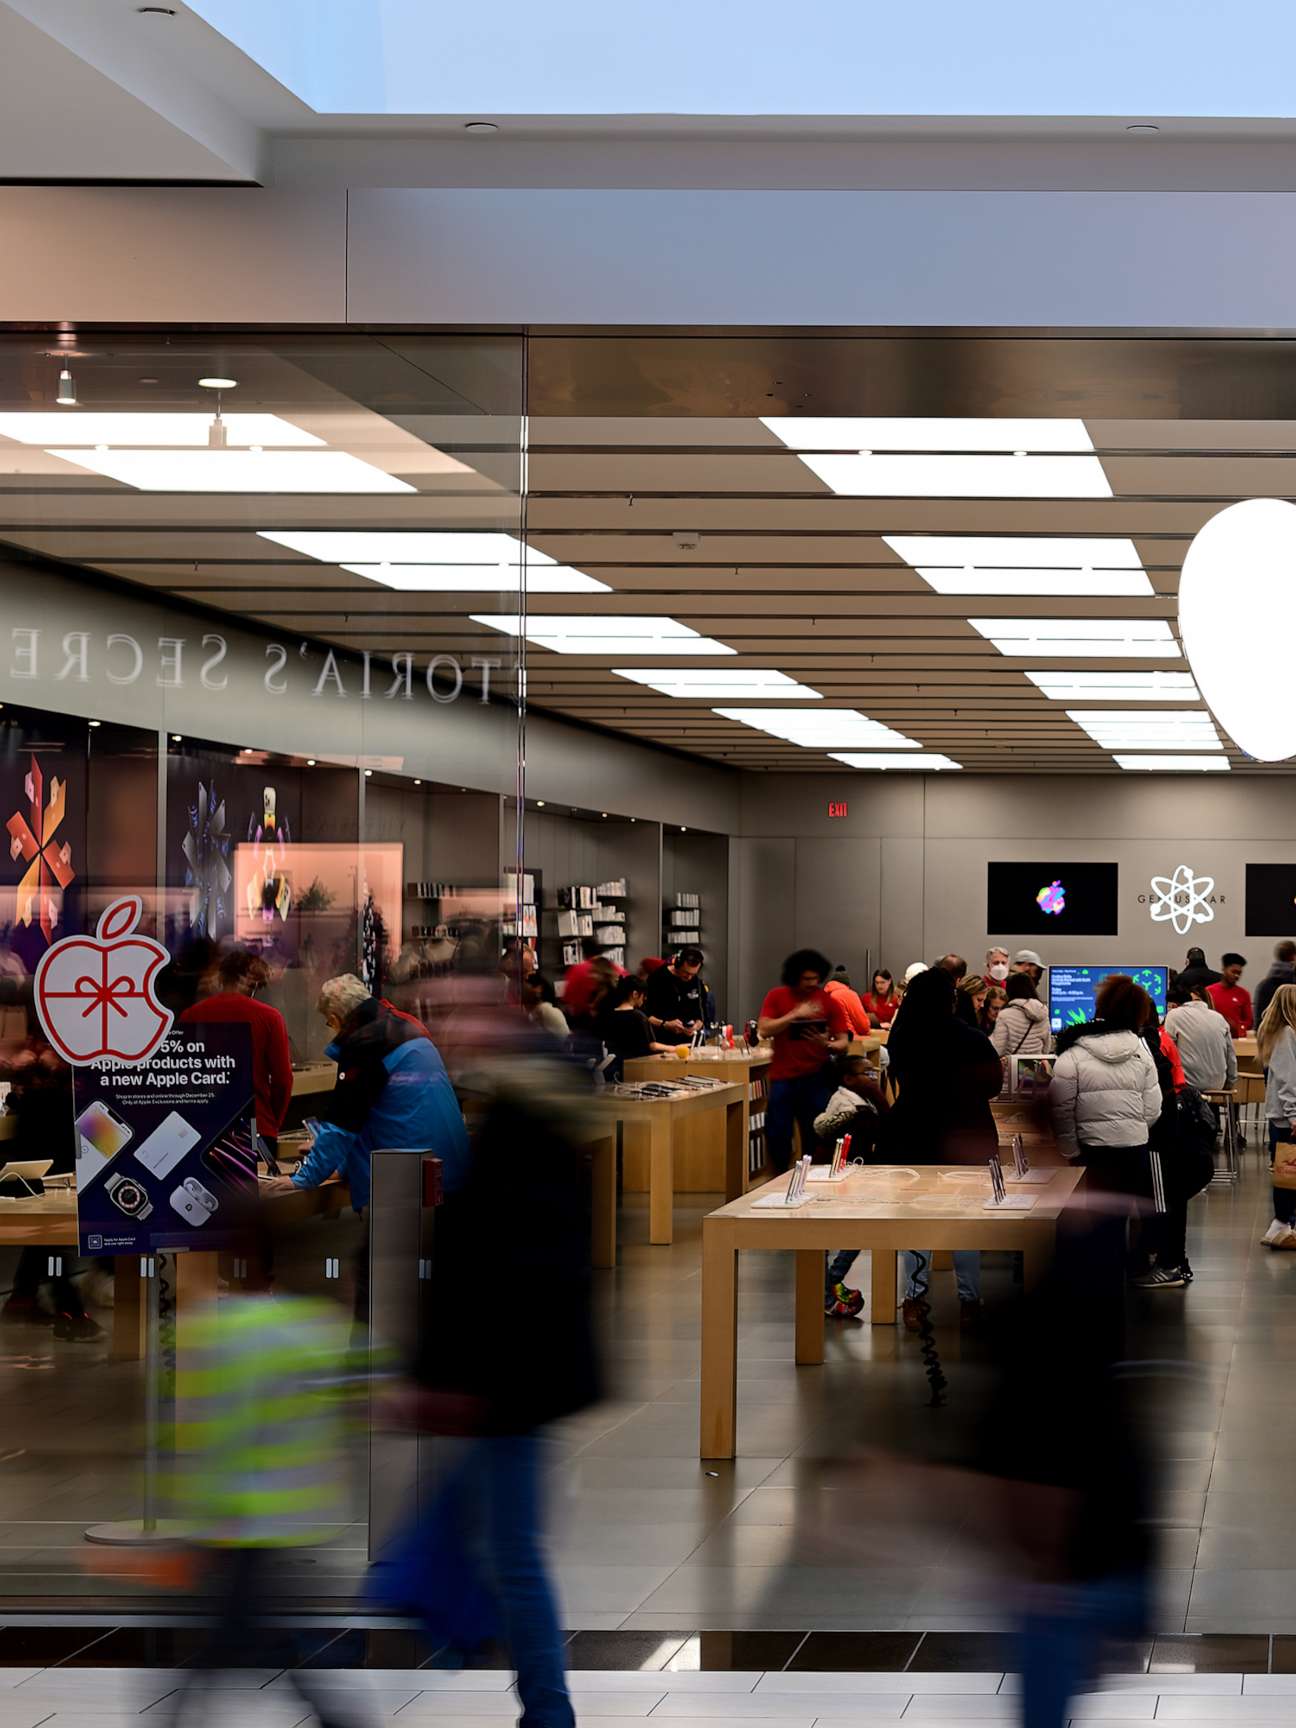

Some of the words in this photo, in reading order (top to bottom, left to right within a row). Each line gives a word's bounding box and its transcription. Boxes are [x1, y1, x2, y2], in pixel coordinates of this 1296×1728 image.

[829, 801, 848, 816] EXIT
[1202, 894, 1226, 904] AR
[187, 1042, 205, 1053] on
[137, 1057, 201, 1071] products
[205, 1055, 236, 1069] with
[100, 1076, 109, 1086] a
[112, 1075, 143, 1086] new
[146, 1073, 188, 1087] Apple
